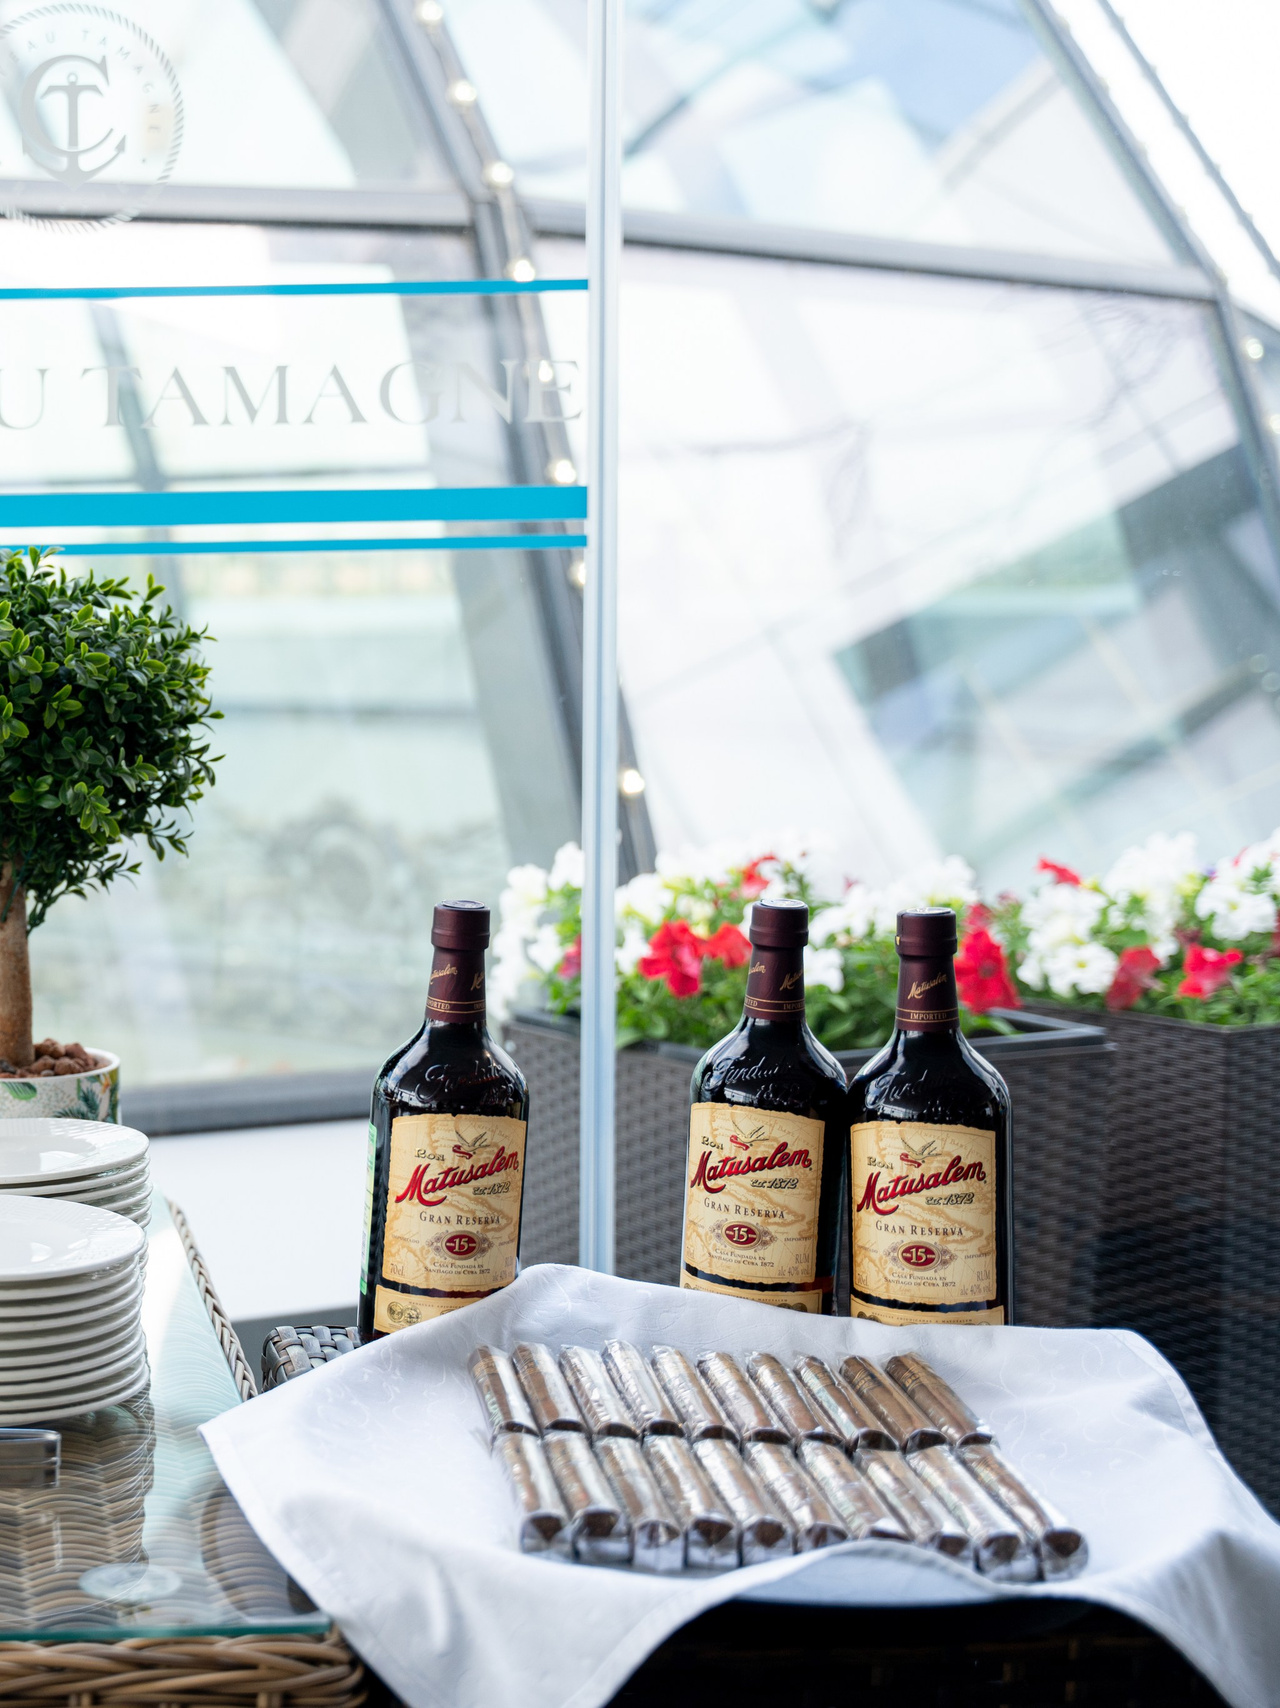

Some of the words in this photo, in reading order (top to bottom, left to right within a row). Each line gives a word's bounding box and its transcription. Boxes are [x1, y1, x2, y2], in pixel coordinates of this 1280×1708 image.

[80, 29, 161, 135] TAMAGNE
[81, 358, 584, 429] TAMAGNE
[907, 972, 948, 1000] Matusalem
[910, 1012, 947, 1020] IMPORTED
[690, 1141, 813, 1194] Matusalem
[394, 1145, 519, 1207] Matusalem
[767, 1177, 799, 1189] 1872
[487, 1181, 511, 1195] 1872
[856, 1155, 987, 1216] Matusalem
[942, 1191, 975, 1206] 1872
[704, 1197, 730, 1212] GRAN
[735, 1204, 785, 1219] RESERVA
[420, 1211, 452, 1225] GRAN
[456, 1214, 501, 1225] RESERVA
[733, 1226, 749, 1242] 15
[875, 1219, 905, 1235] GRAN
[910, 1224, 964, 1236] RESERVA
[453, 1238, 469, 1252] 15
[910, 1248, 927, 1263] 15
